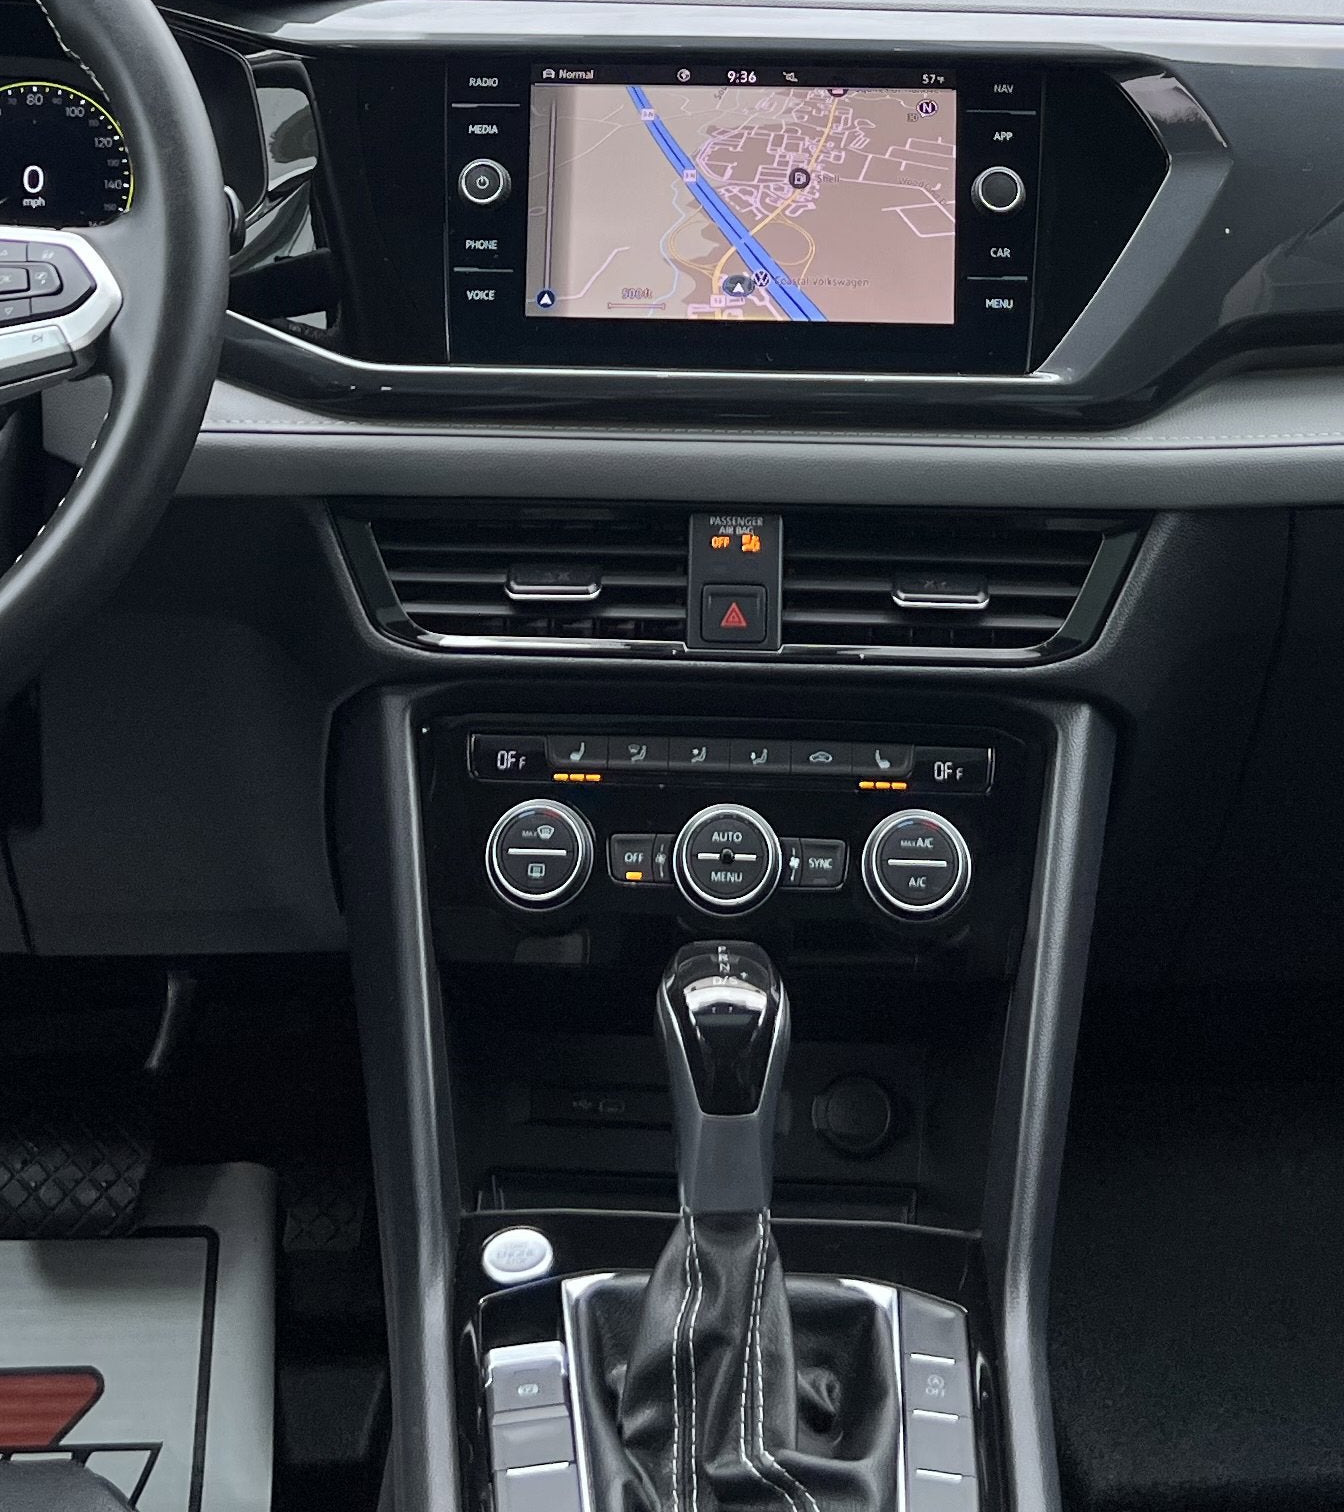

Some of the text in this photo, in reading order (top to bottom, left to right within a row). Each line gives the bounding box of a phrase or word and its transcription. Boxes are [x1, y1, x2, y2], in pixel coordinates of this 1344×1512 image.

[558, 69, 595, 80] Normal
[727, 71, 758, 85] 9:36
[468, 77, 499, 88] RADIO
[993, 84, 1015, 95] NAV
[26, 93, 44, 106] 80
[65, 106, 85, 118] 100
[468, 124, 498, 135] MEDIA
[992, 131, 1014, 142] APP
[94, 137, 114, 149] 120
[23, 164, 45, 194] 0
[816, 173, 841, 184] Shell
[103, 179, 123, 191] 140
[22, 196, 46, 209] mph
[465, 240, 498, 251] PHONE
[990, 247, 1012, 259] CAR
[466, 290, 497, 301] VOICE
[985, 298, 1014, 310] MENU
[709, 516, 764, 527] PASSENGER
[718, 525, 755, 536] AIR BAG
[711, 536, 731, 549] OFF
[711, 831, 743, 843] AUTO
[916, 837, 934, 849] A/C
[624, 852, 644, 865] OFF
[808, 858, 833, 870] SYNC
[710, 871, 743, 883] MENU
[908, 876, 927, 889] A/C
[719, 962, 731, 974] N
